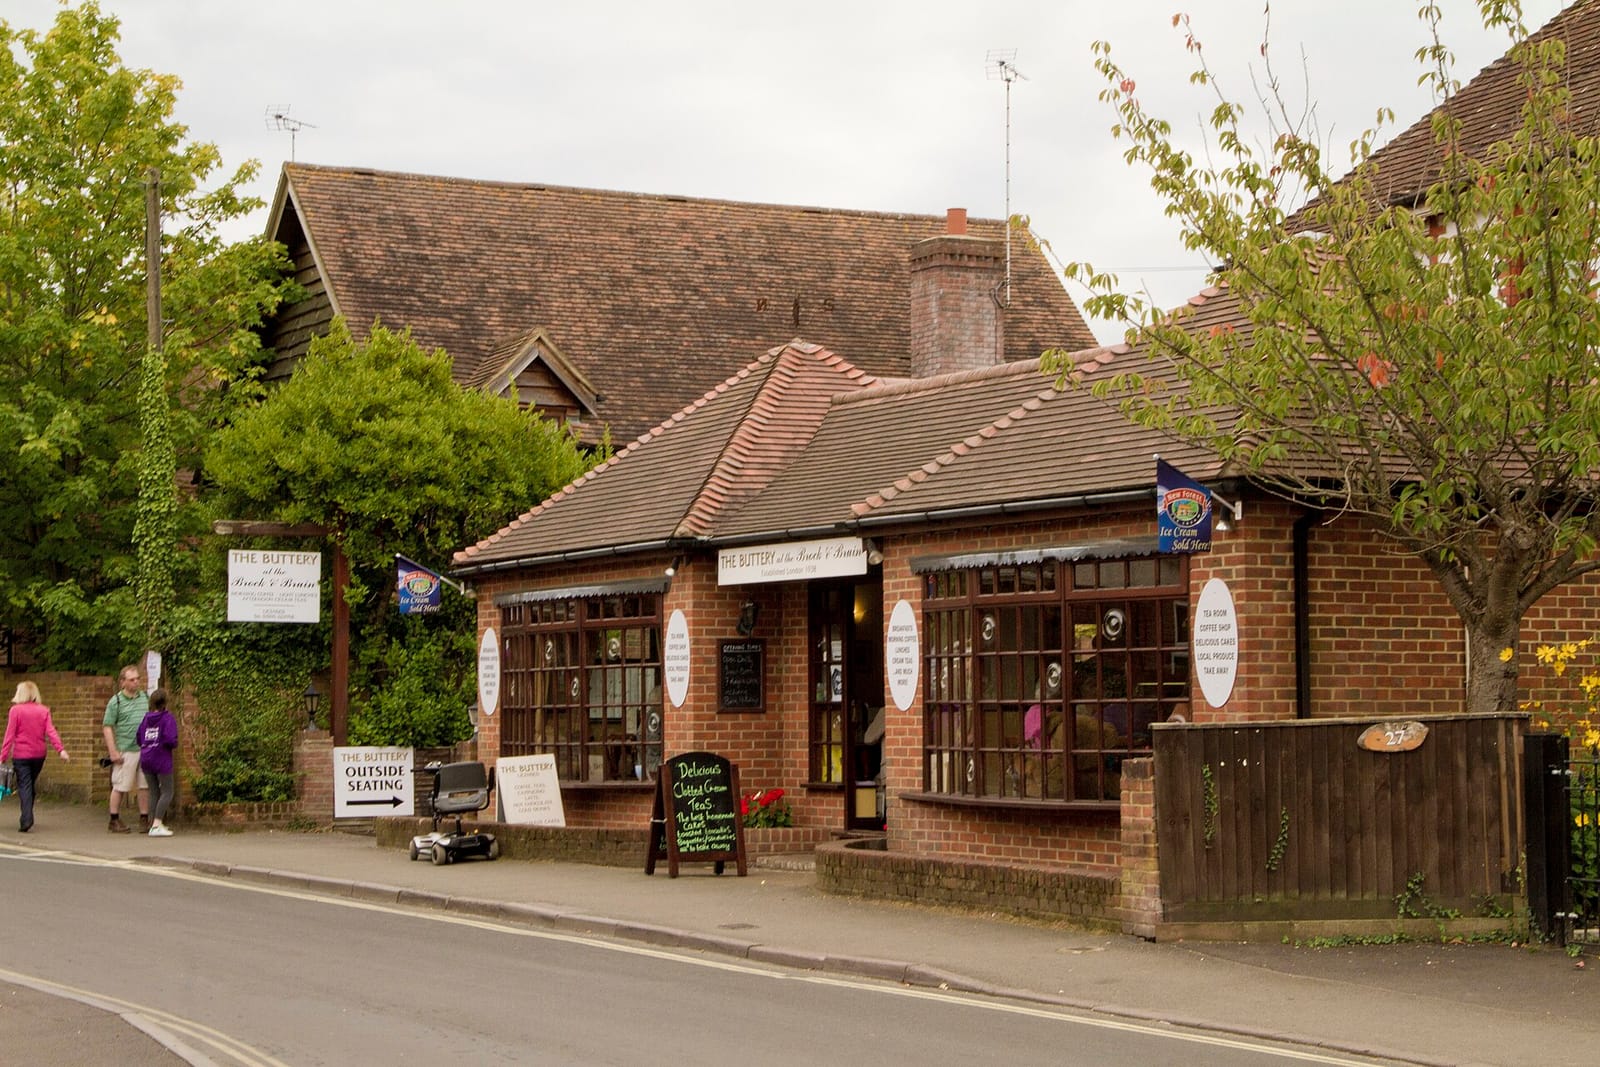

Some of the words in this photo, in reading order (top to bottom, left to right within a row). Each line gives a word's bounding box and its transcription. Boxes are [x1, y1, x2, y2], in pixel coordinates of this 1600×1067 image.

[1160, 527, 1172, 536] Ice
[1174, 527, 1198, 537] Cream
[1172, 538, 1190, 550] Sold
[232, 552, 257, 564] THE
[262, 553, 317, 565] BUTTERY
[721, 555, 736, 569] THE
[739, 551, 775, 567] BUTTERY
[1213, 652, 1235, 660] PRODUCE
[1385, 730, 1405, 746] 27
[341, 752, 361, 762] THE
[364, 752, 408, 761] BUTTERY
[346, 765, 405, 777] OUTSIDE
[519, 762, 553, 772] BUTTERY
[679, 762, 721, 778] Delicious
[348, 780, 403, 791] SEATING
[673, 782, 704, 798] Clotted
[704, 779, 727, 793] Cream
[676, 811, 689, 823] The
[691, 812, 704, 821] best
[706, 810, 735, 820] homemade
[711, 843, 730, 852] away
